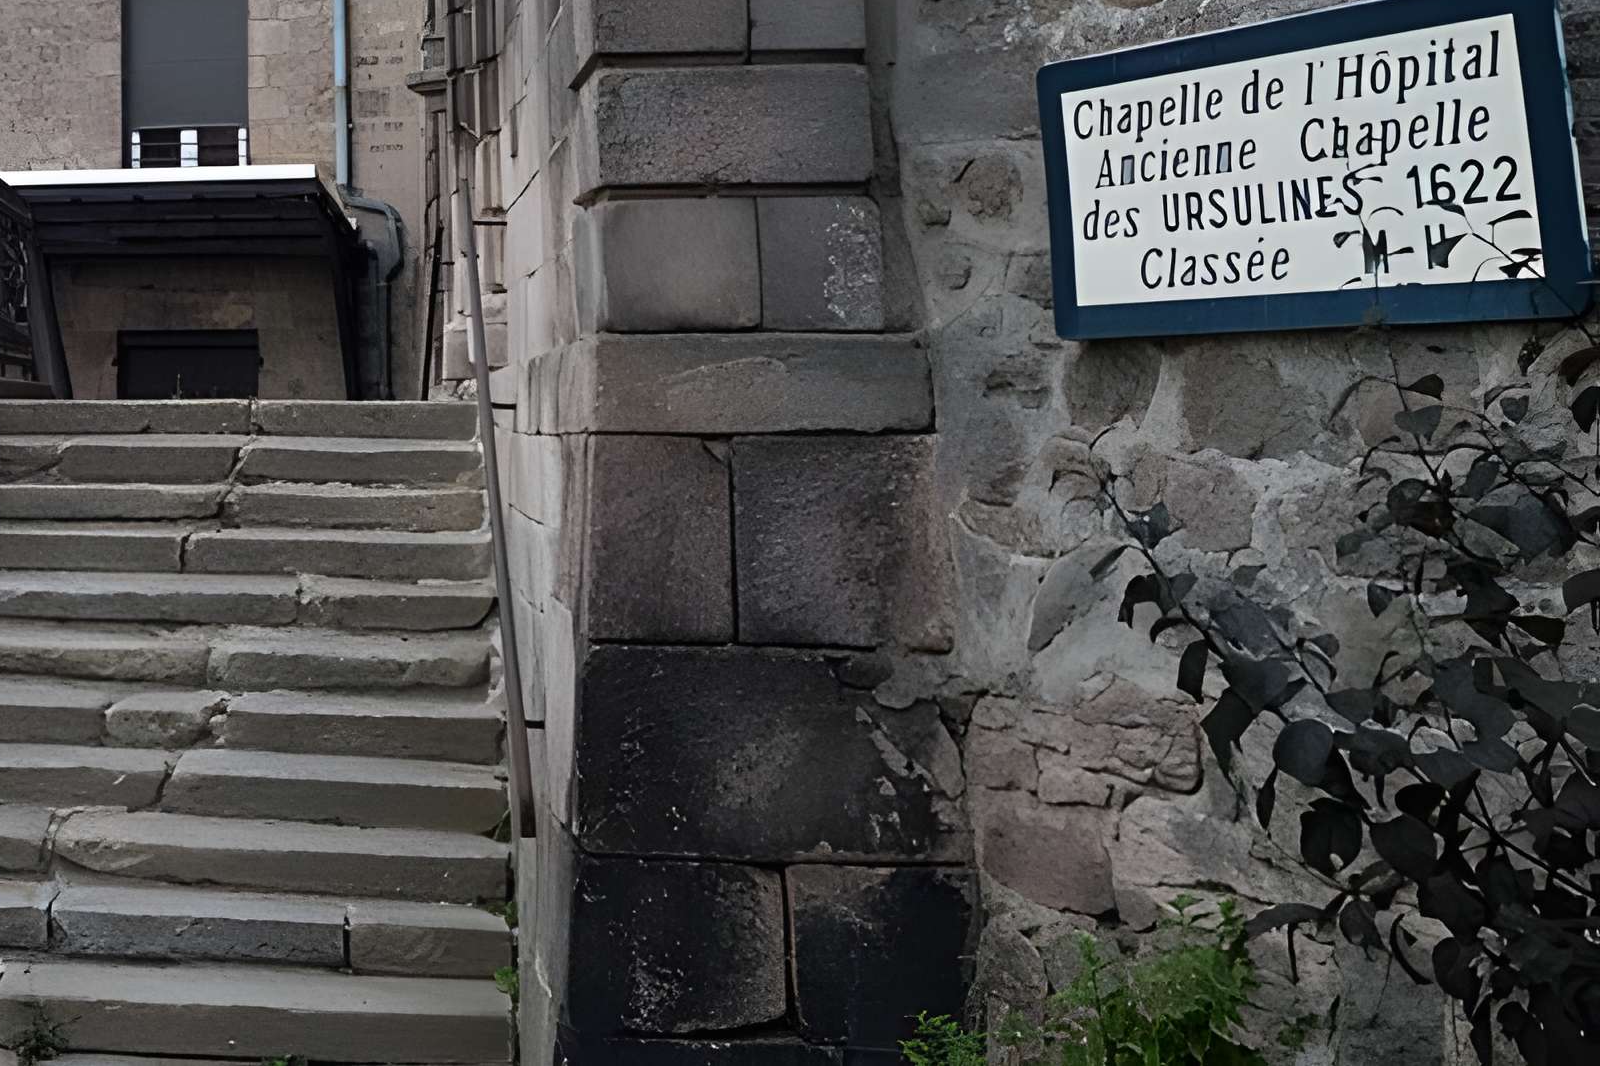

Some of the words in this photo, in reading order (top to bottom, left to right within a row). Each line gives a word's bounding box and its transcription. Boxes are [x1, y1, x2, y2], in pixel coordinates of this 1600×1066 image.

[1073, 81, 1223, 143] Chapelle
[1241, 69, 1284, 115] de
[1095, 138, 1257, 189] Ancienne
[1300, 98, 1490, 166] Chapelle
[1083, 199, 1140, 241] des
[1162, 167, 1364, 233] URSULINES
[1406, 155, 1521, 209] 1622
[1140, 237, 1290, 290] Classée
